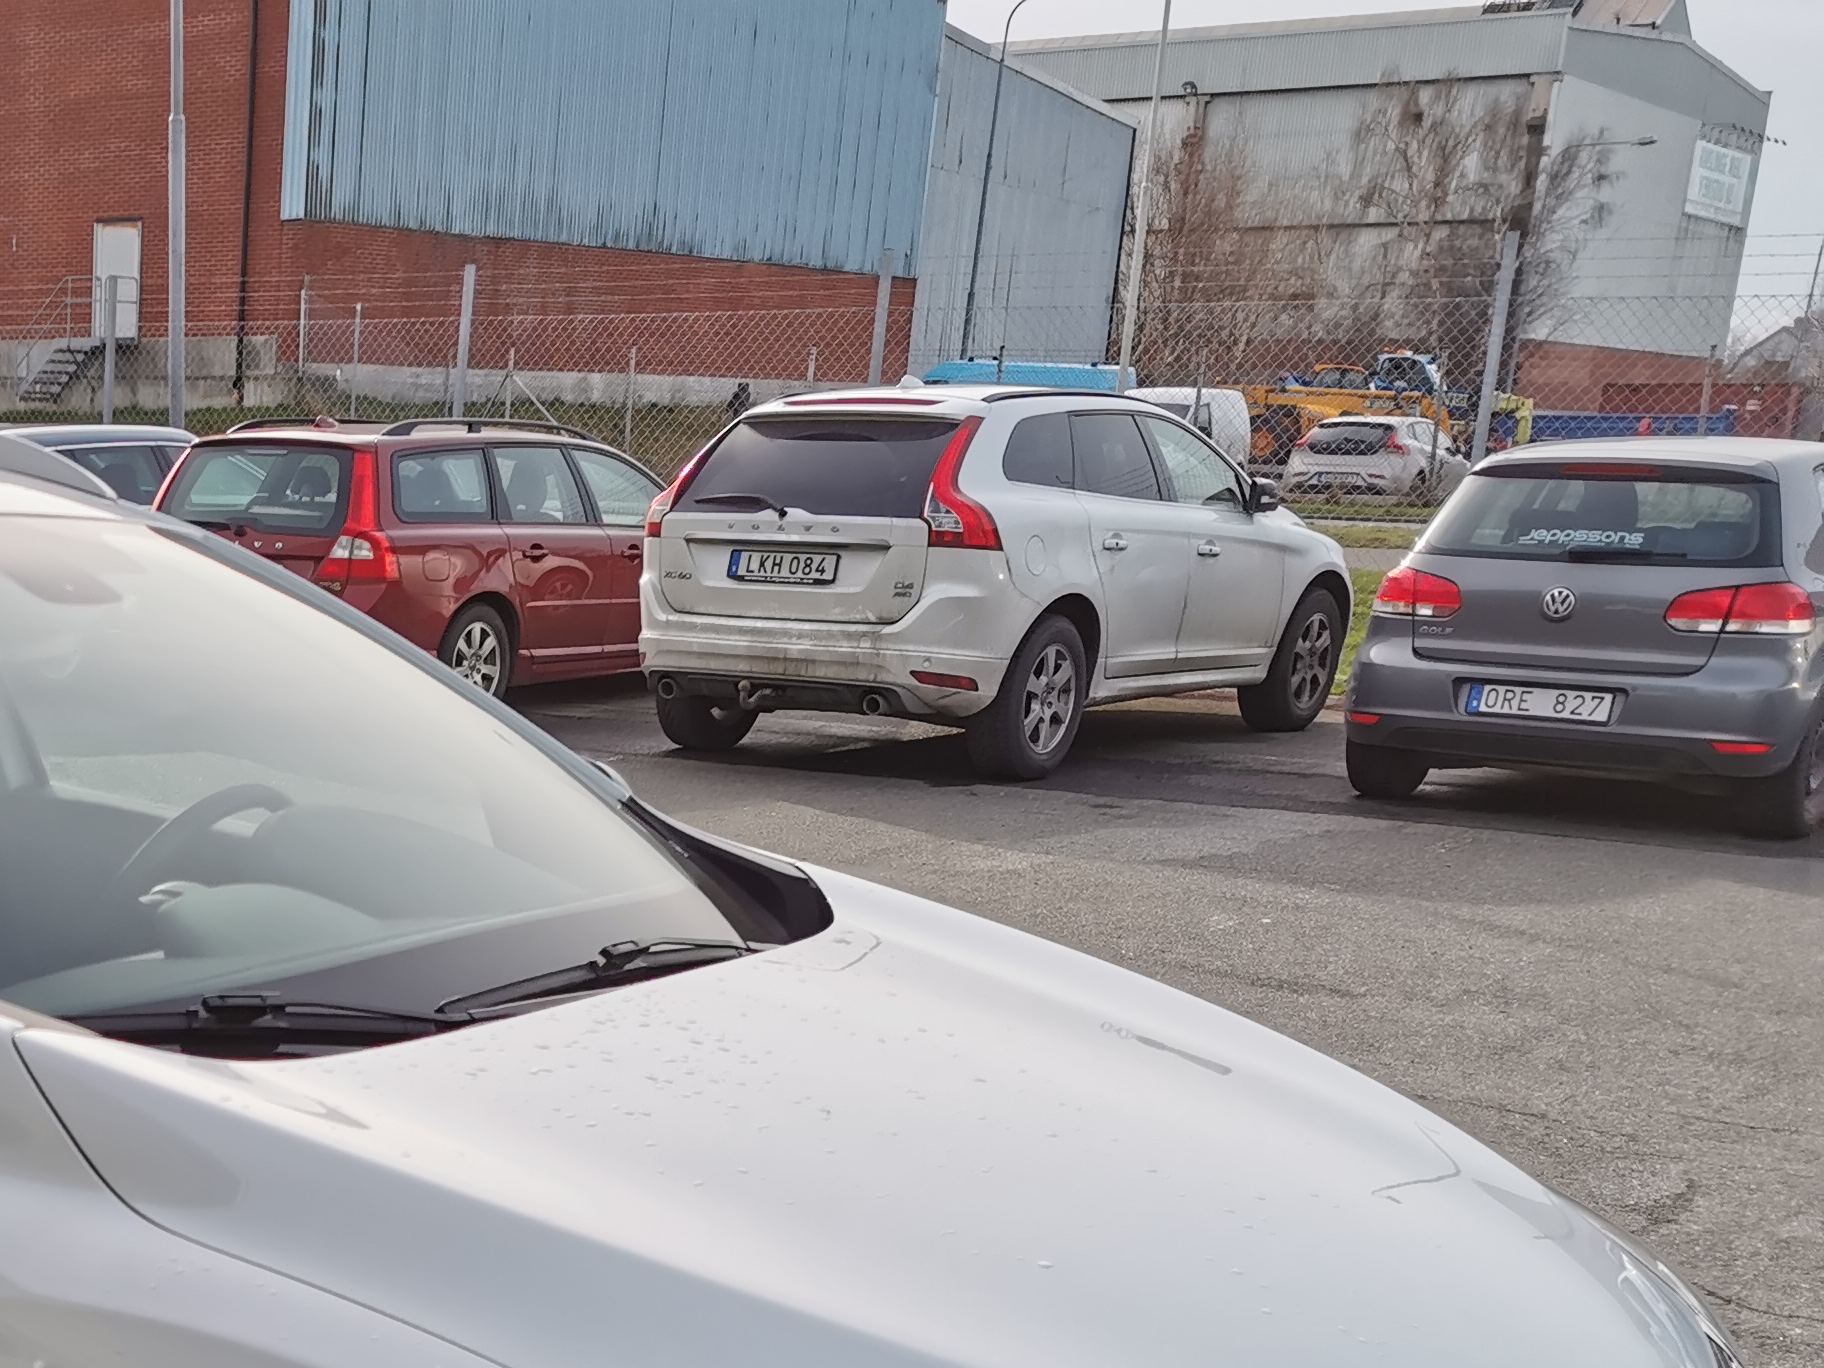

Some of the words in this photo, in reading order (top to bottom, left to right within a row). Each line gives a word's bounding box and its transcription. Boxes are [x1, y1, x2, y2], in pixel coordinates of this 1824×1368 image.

[745, 554, 784, 575] LKH
[788, 556, 827, 577] 084
[1419, 625, 1455, 635] GOLF
[1484, 688, 1534, 712] ORE
[1552, 692, 1606, 718] 827
